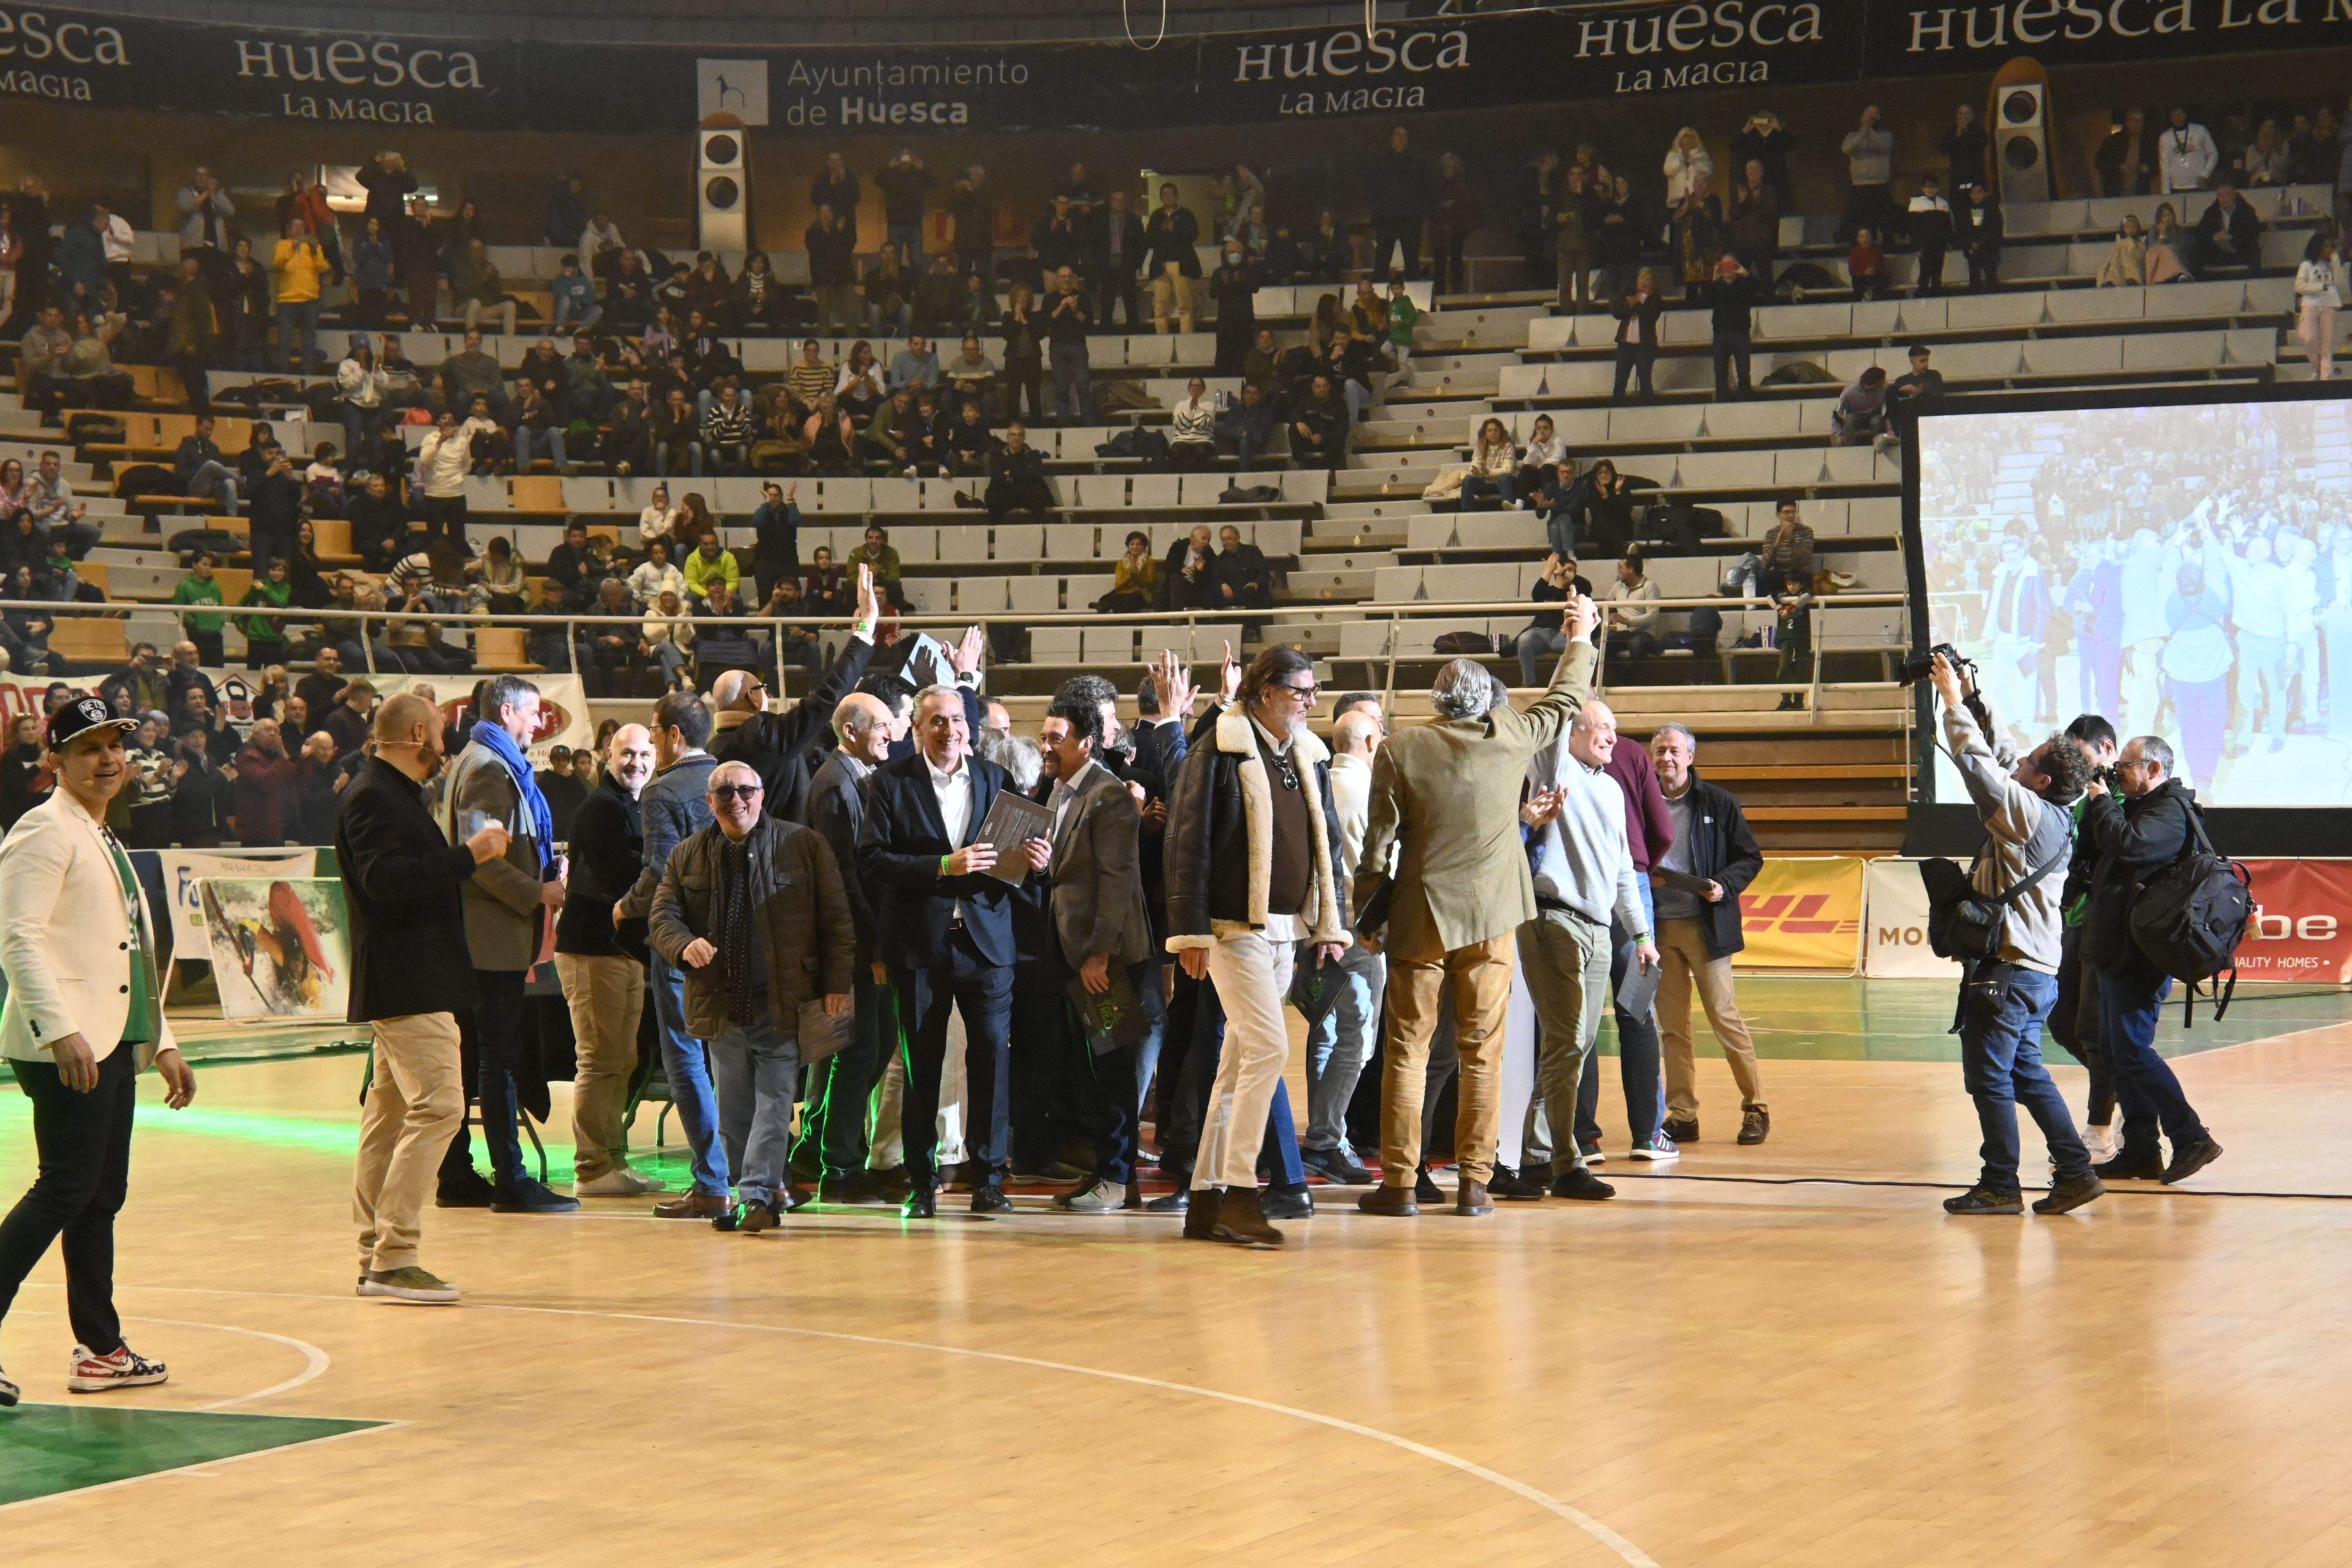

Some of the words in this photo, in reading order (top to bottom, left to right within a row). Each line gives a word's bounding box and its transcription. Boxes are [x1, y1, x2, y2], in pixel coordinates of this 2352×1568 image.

[1574, 0, 1824, 58] Huesca
[234, 40, 484, 89] Huesca
[1234, 28, 1470, 82] Huesca
[787, 57, 1028, 94] Ayuntamiento
[787, 97, 826, 125] de
[841, 97, 968, 124] Huesca
[1787, 618, 1794, 629] 2
[81, 700, 105, 712] NETS
[1879, 927, 1931, 945] MO
[2278, 957, 2319, 968] HOMES
